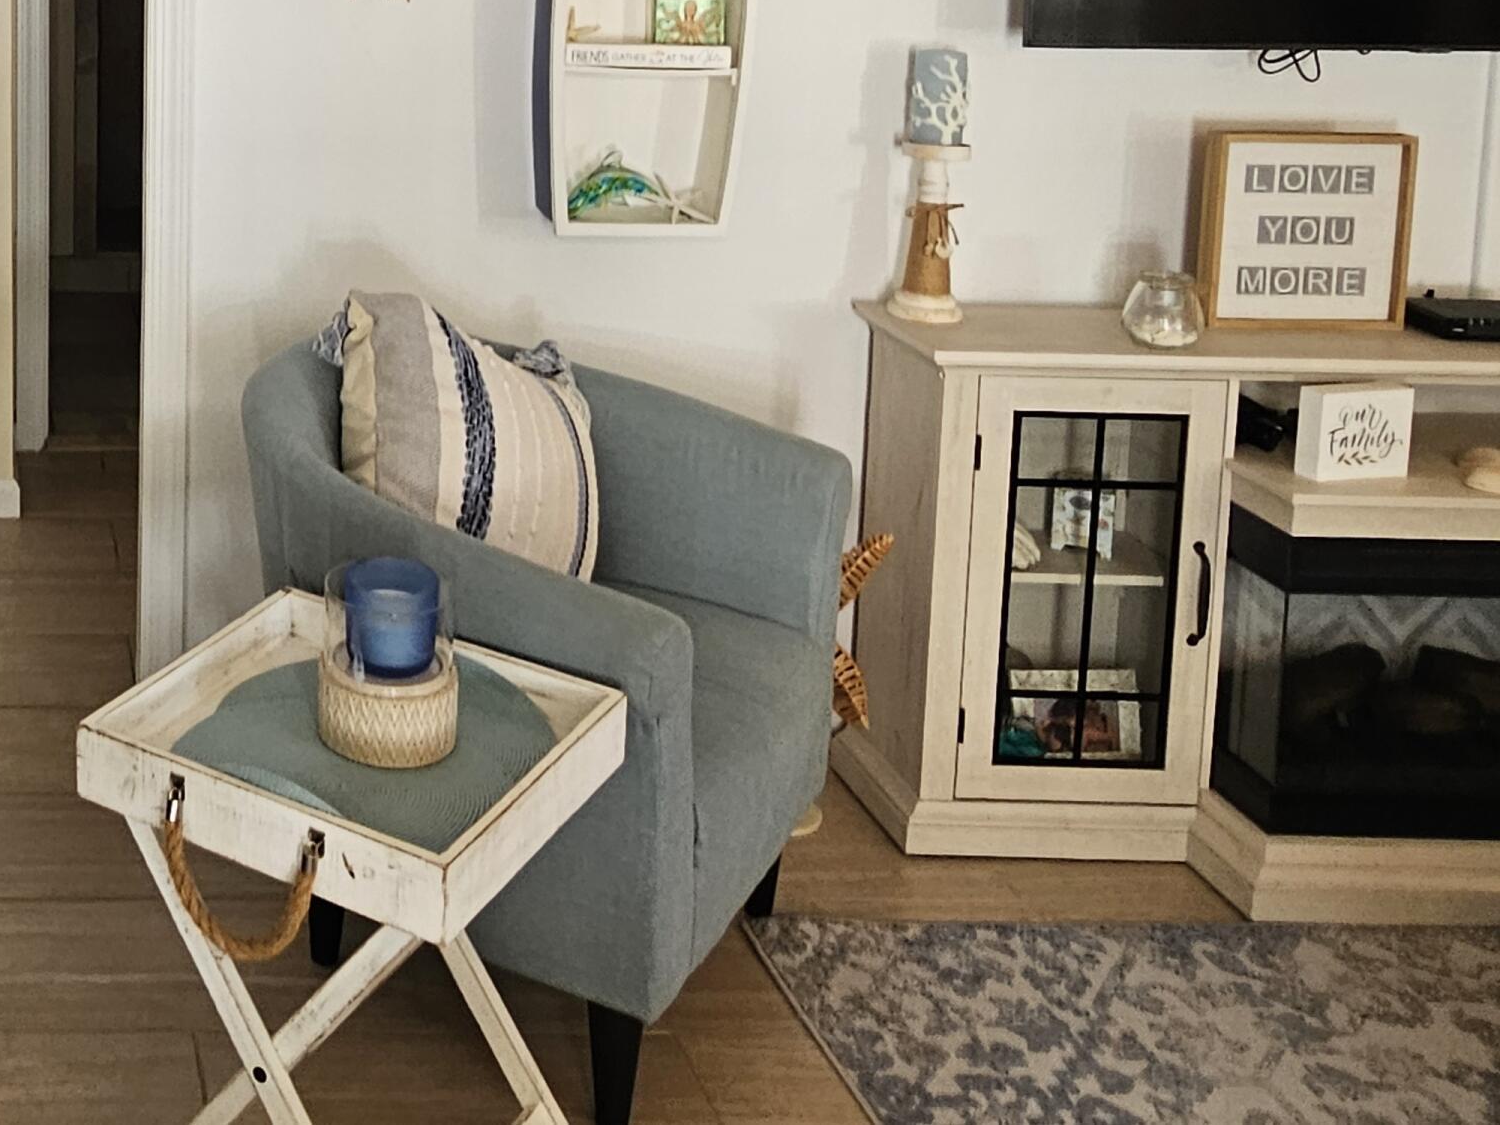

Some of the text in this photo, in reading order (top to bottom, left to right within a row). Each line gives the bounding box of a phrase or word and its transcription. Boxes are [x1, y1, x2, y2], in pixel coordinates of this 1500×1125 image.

[571, 49, 609, 64] FRIENDS
[1252, 167, 1372, 192] LOVE
[1264, 219, 1352, 243] YOU
[1239, 269, 1360, 294] MORE
